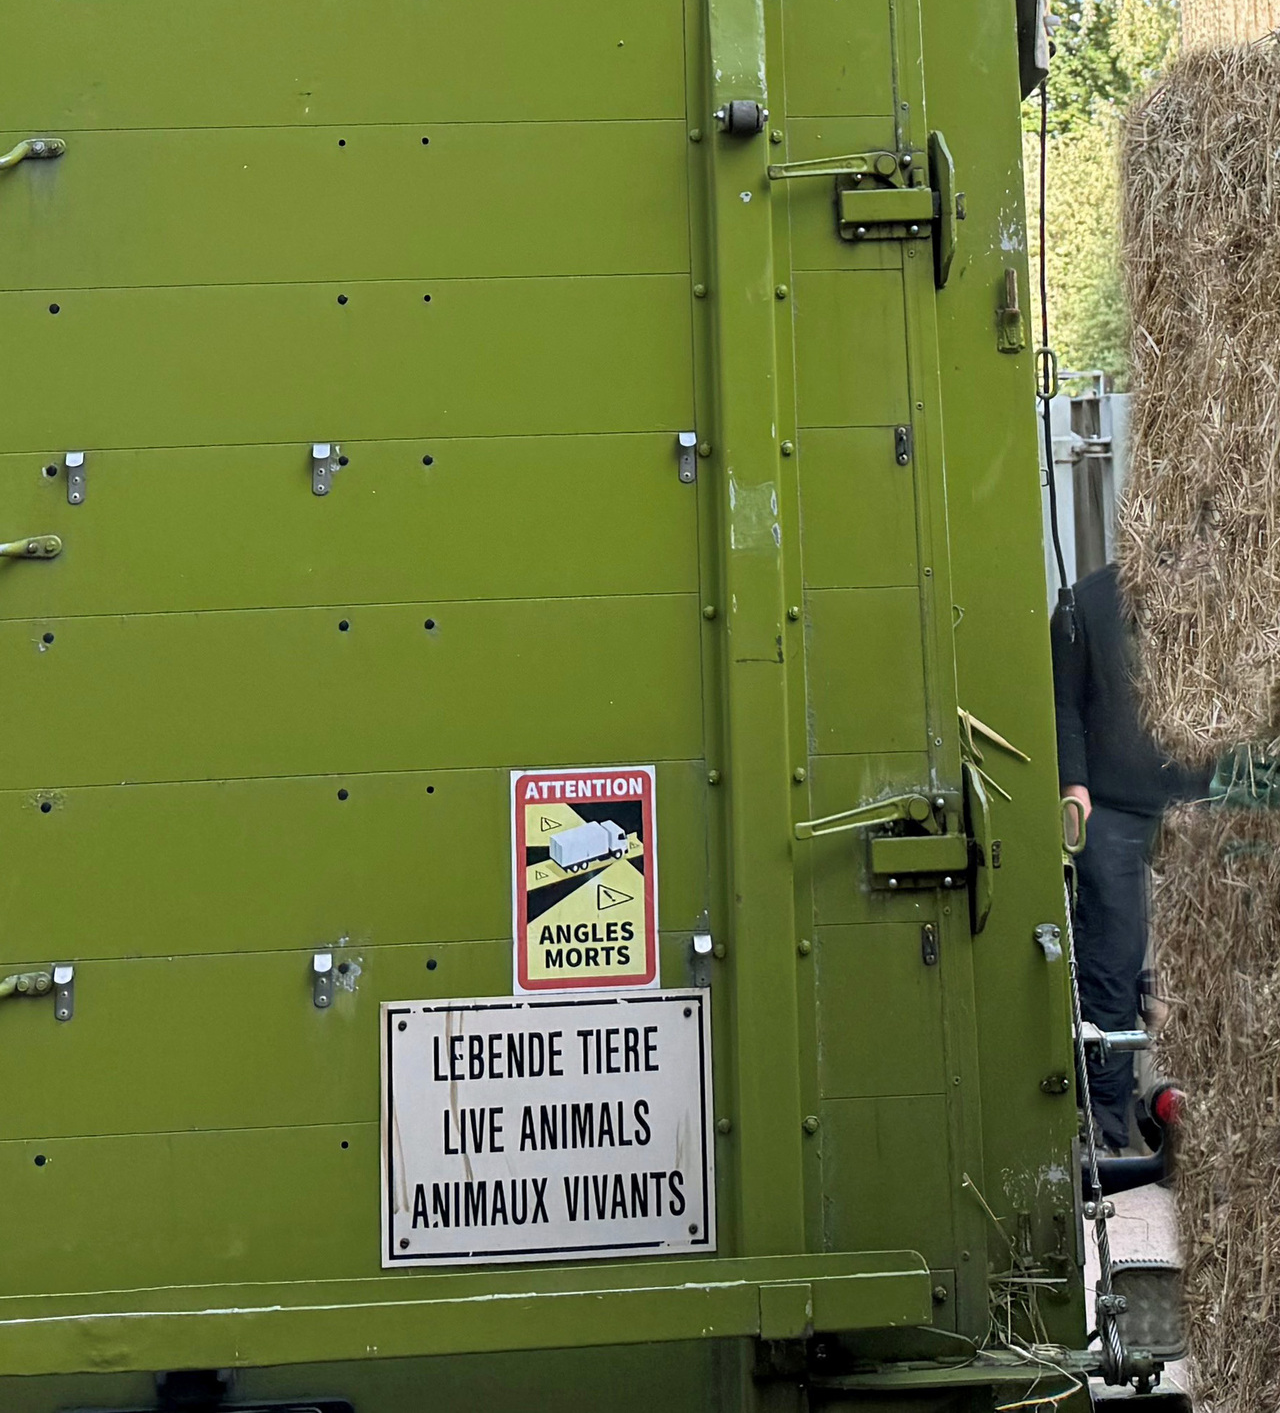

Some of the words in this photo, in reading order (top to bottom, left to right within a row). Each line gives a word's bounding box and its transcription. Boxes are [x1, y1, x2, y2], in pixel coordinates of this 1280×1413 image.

[524, 777, 643, 800] ATTENTION
[539, 921, 634, 945] ANGLES
[544, 945, 631, 969] MORTS
[433, 1031, 563, 1081] LEBENDE
[577, 1026, 660, 1073] TIERE
[443, 1107, 504, 1155] LIVE
[520, 1099, 651, 1152] ANIMALS
[412, 1176, 549, 1229] ANIMAUX
[563, 1170, 686, 1221] VIVANTS
